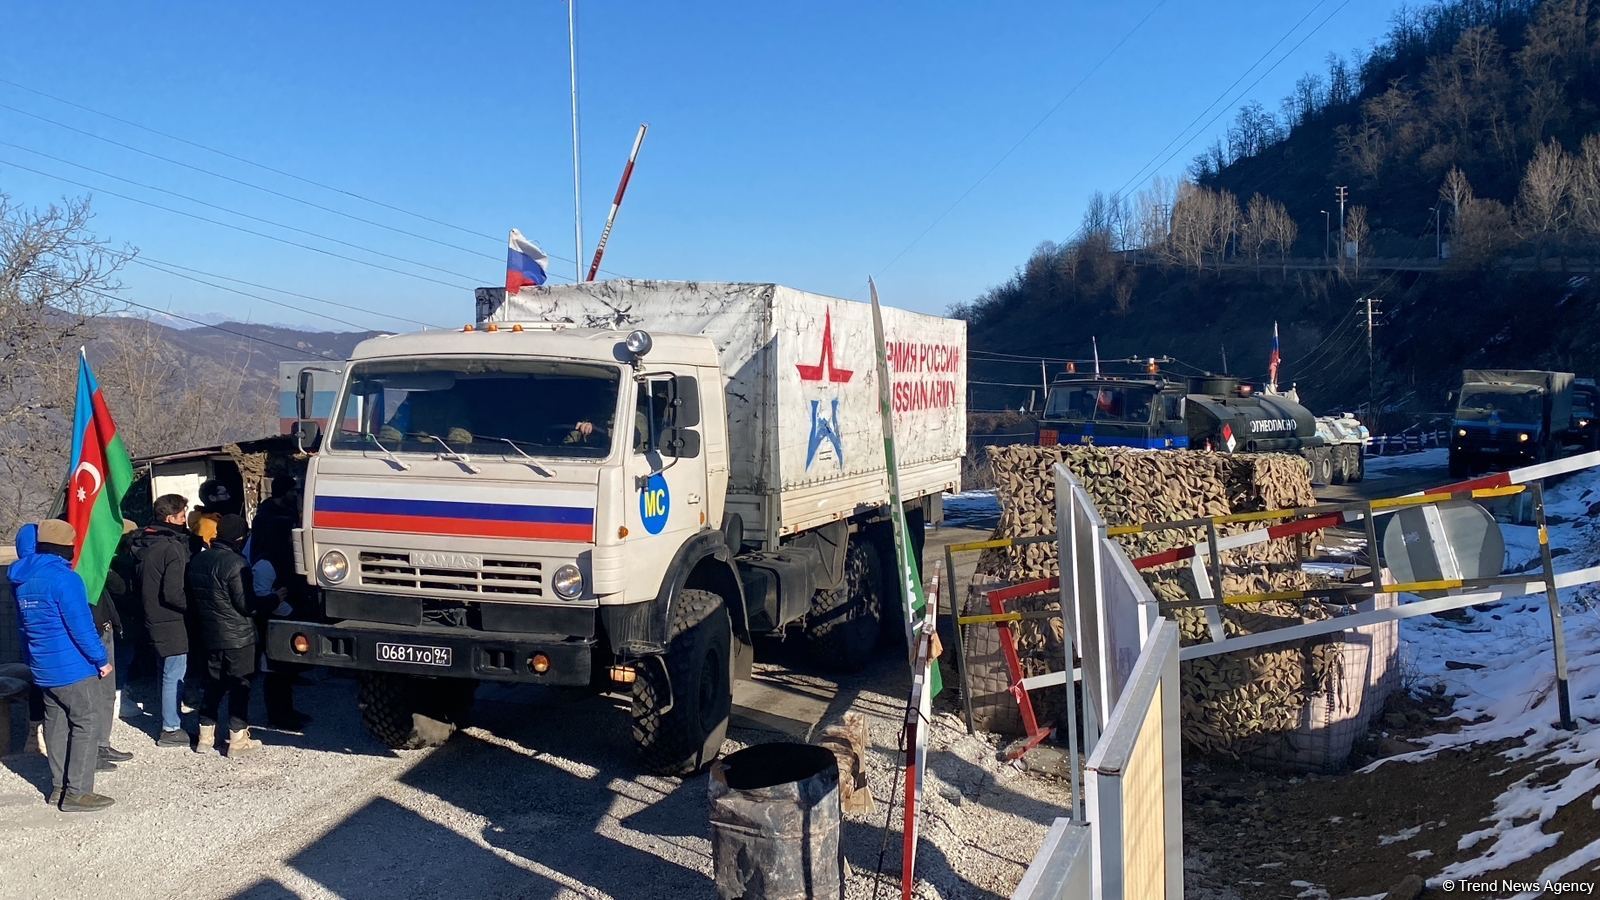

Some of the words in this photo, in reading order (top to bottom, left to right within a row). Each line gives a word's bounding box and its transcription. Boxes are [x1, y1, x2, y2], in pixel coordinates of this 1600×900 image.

[885, 341, 917, 373] РМИЯ
[920, 342, 960, 373] РОССИИ
[929, 380, 957, 408] ARMY
[1250, 419, 1297, 433] ОГНЕОПАСНО
[644, 489, 666, 518] МС
[434, 648, 448, 661] 94
